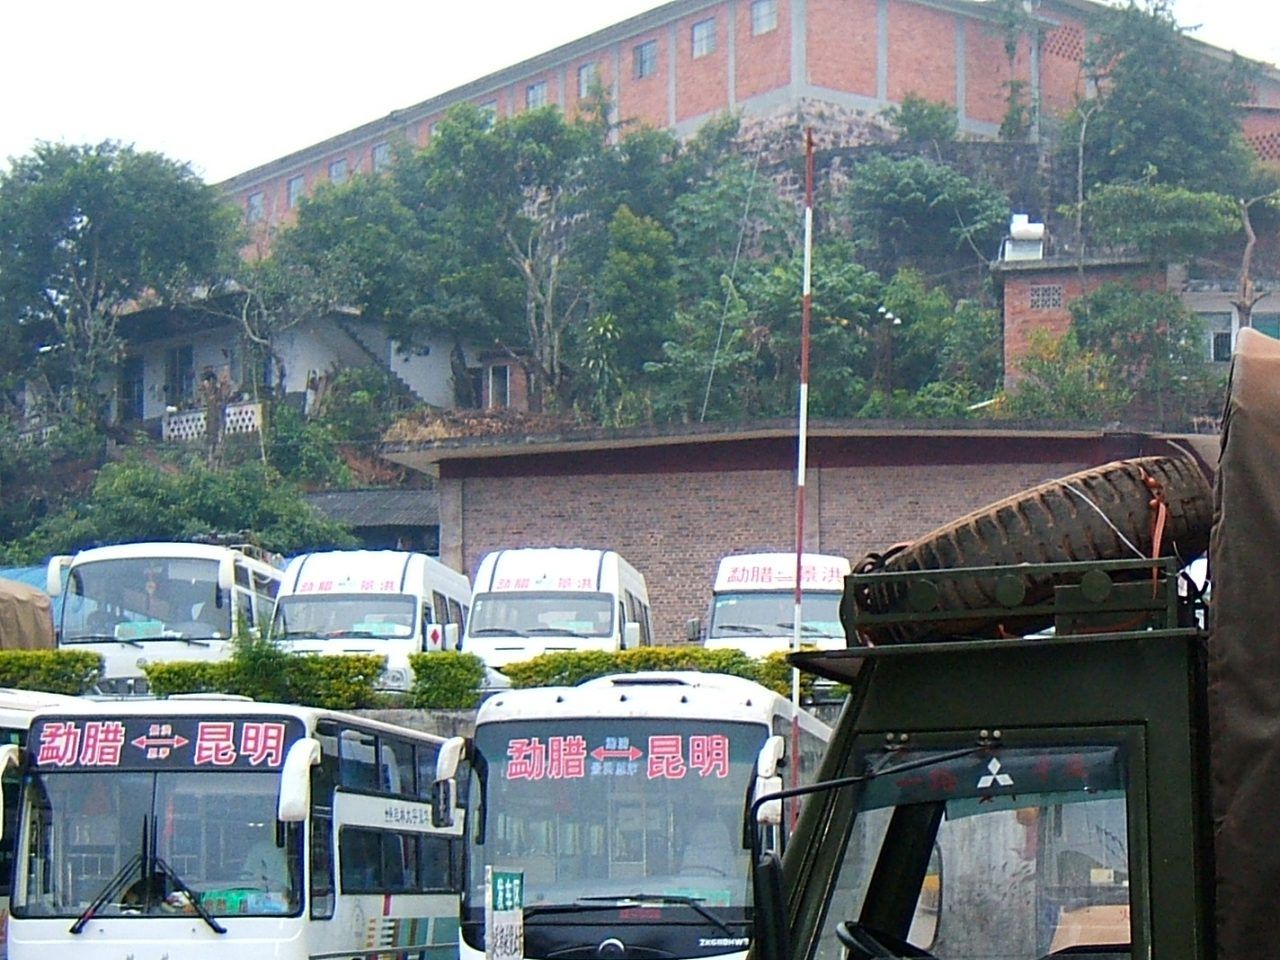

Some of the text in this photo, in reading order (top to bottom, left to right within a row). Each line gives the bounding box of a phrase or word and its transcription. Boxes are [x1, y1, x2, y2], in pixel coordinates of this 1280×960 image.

[38, 721, 286, 766] 勐腊 昆明
[506, 735, 729, 780] 勐腊 昆明
